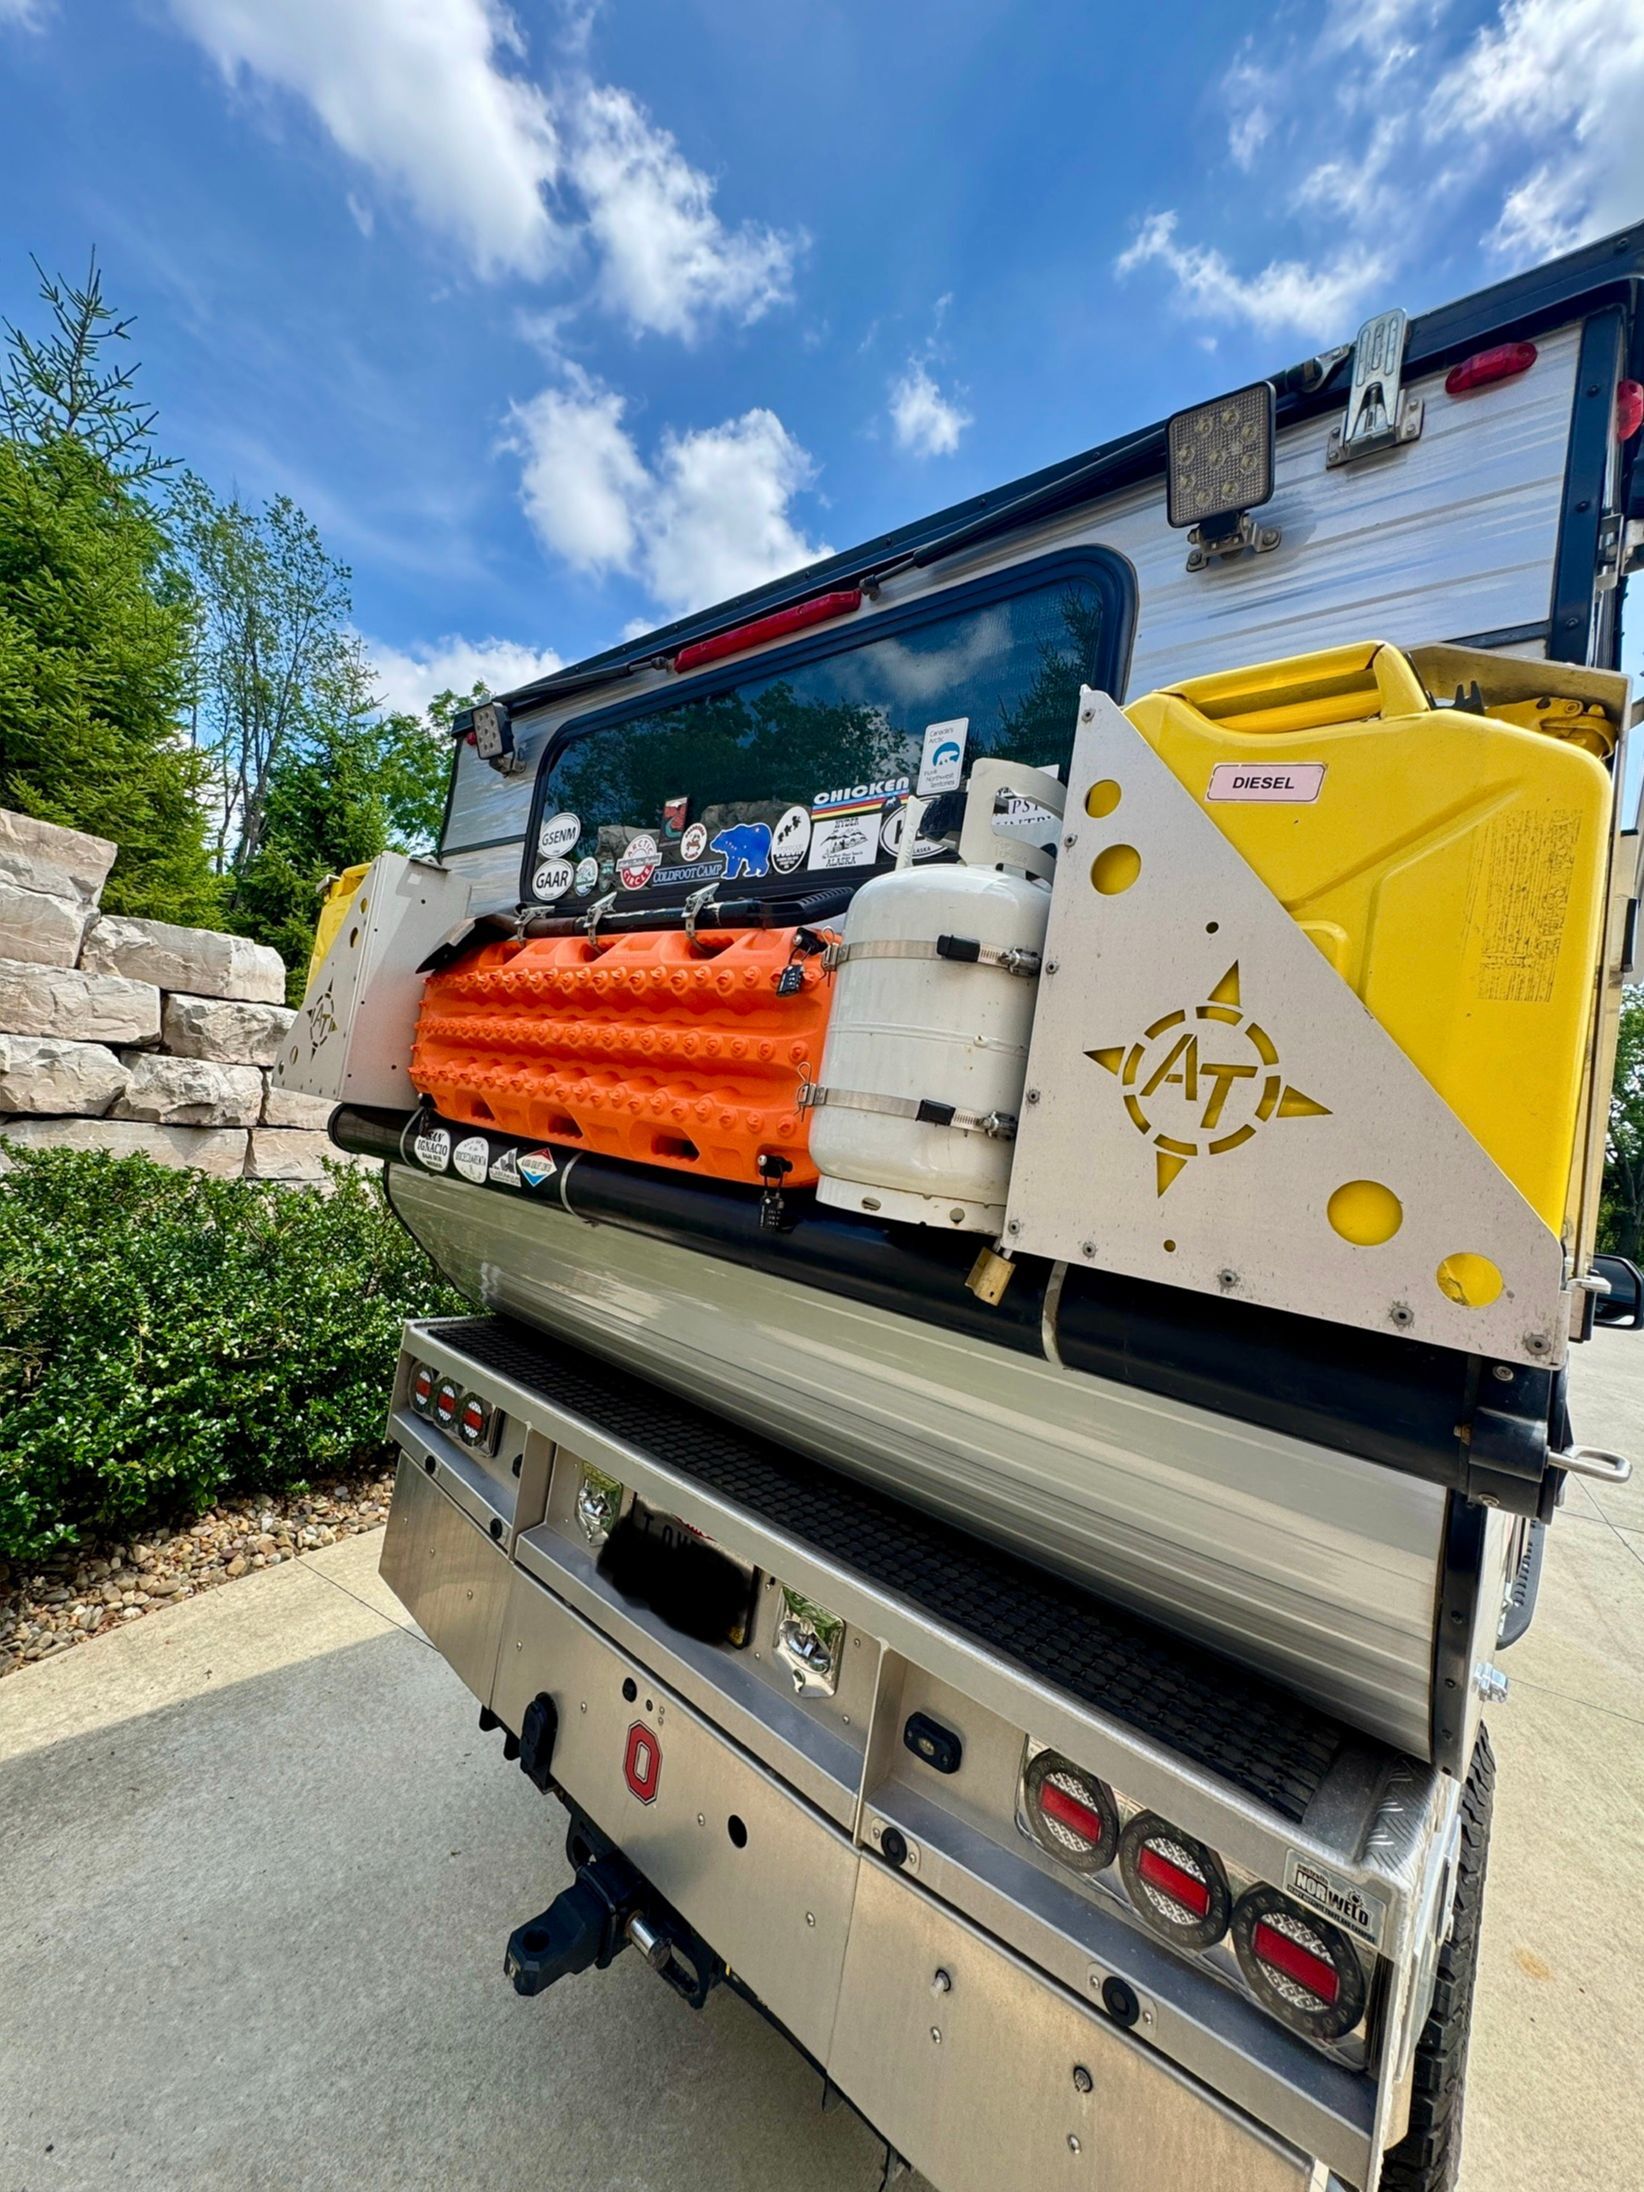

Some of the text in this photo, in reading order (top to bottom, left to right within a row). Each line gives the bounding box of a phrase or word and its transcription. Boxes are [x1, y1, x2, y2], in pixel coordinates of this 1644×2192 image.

[813, 776, 909, 805] CHICKEN
[1232, 777, 1294, 789] DIESEL
[541, 826, 576, 846] GSENM
[627, 839, 654, 857] ARCTIC
[536, 870, 569, 889] GAAR
[622, 864, 653, 887] CIRCLE
[653, 868, 697, 883] COLDFOOT
[1139, 1033, 1258, 1129] AT
[416, 1139, 448, 1156] IGNACIO
[1296, 1870, 1369, 1927] NORWELD
